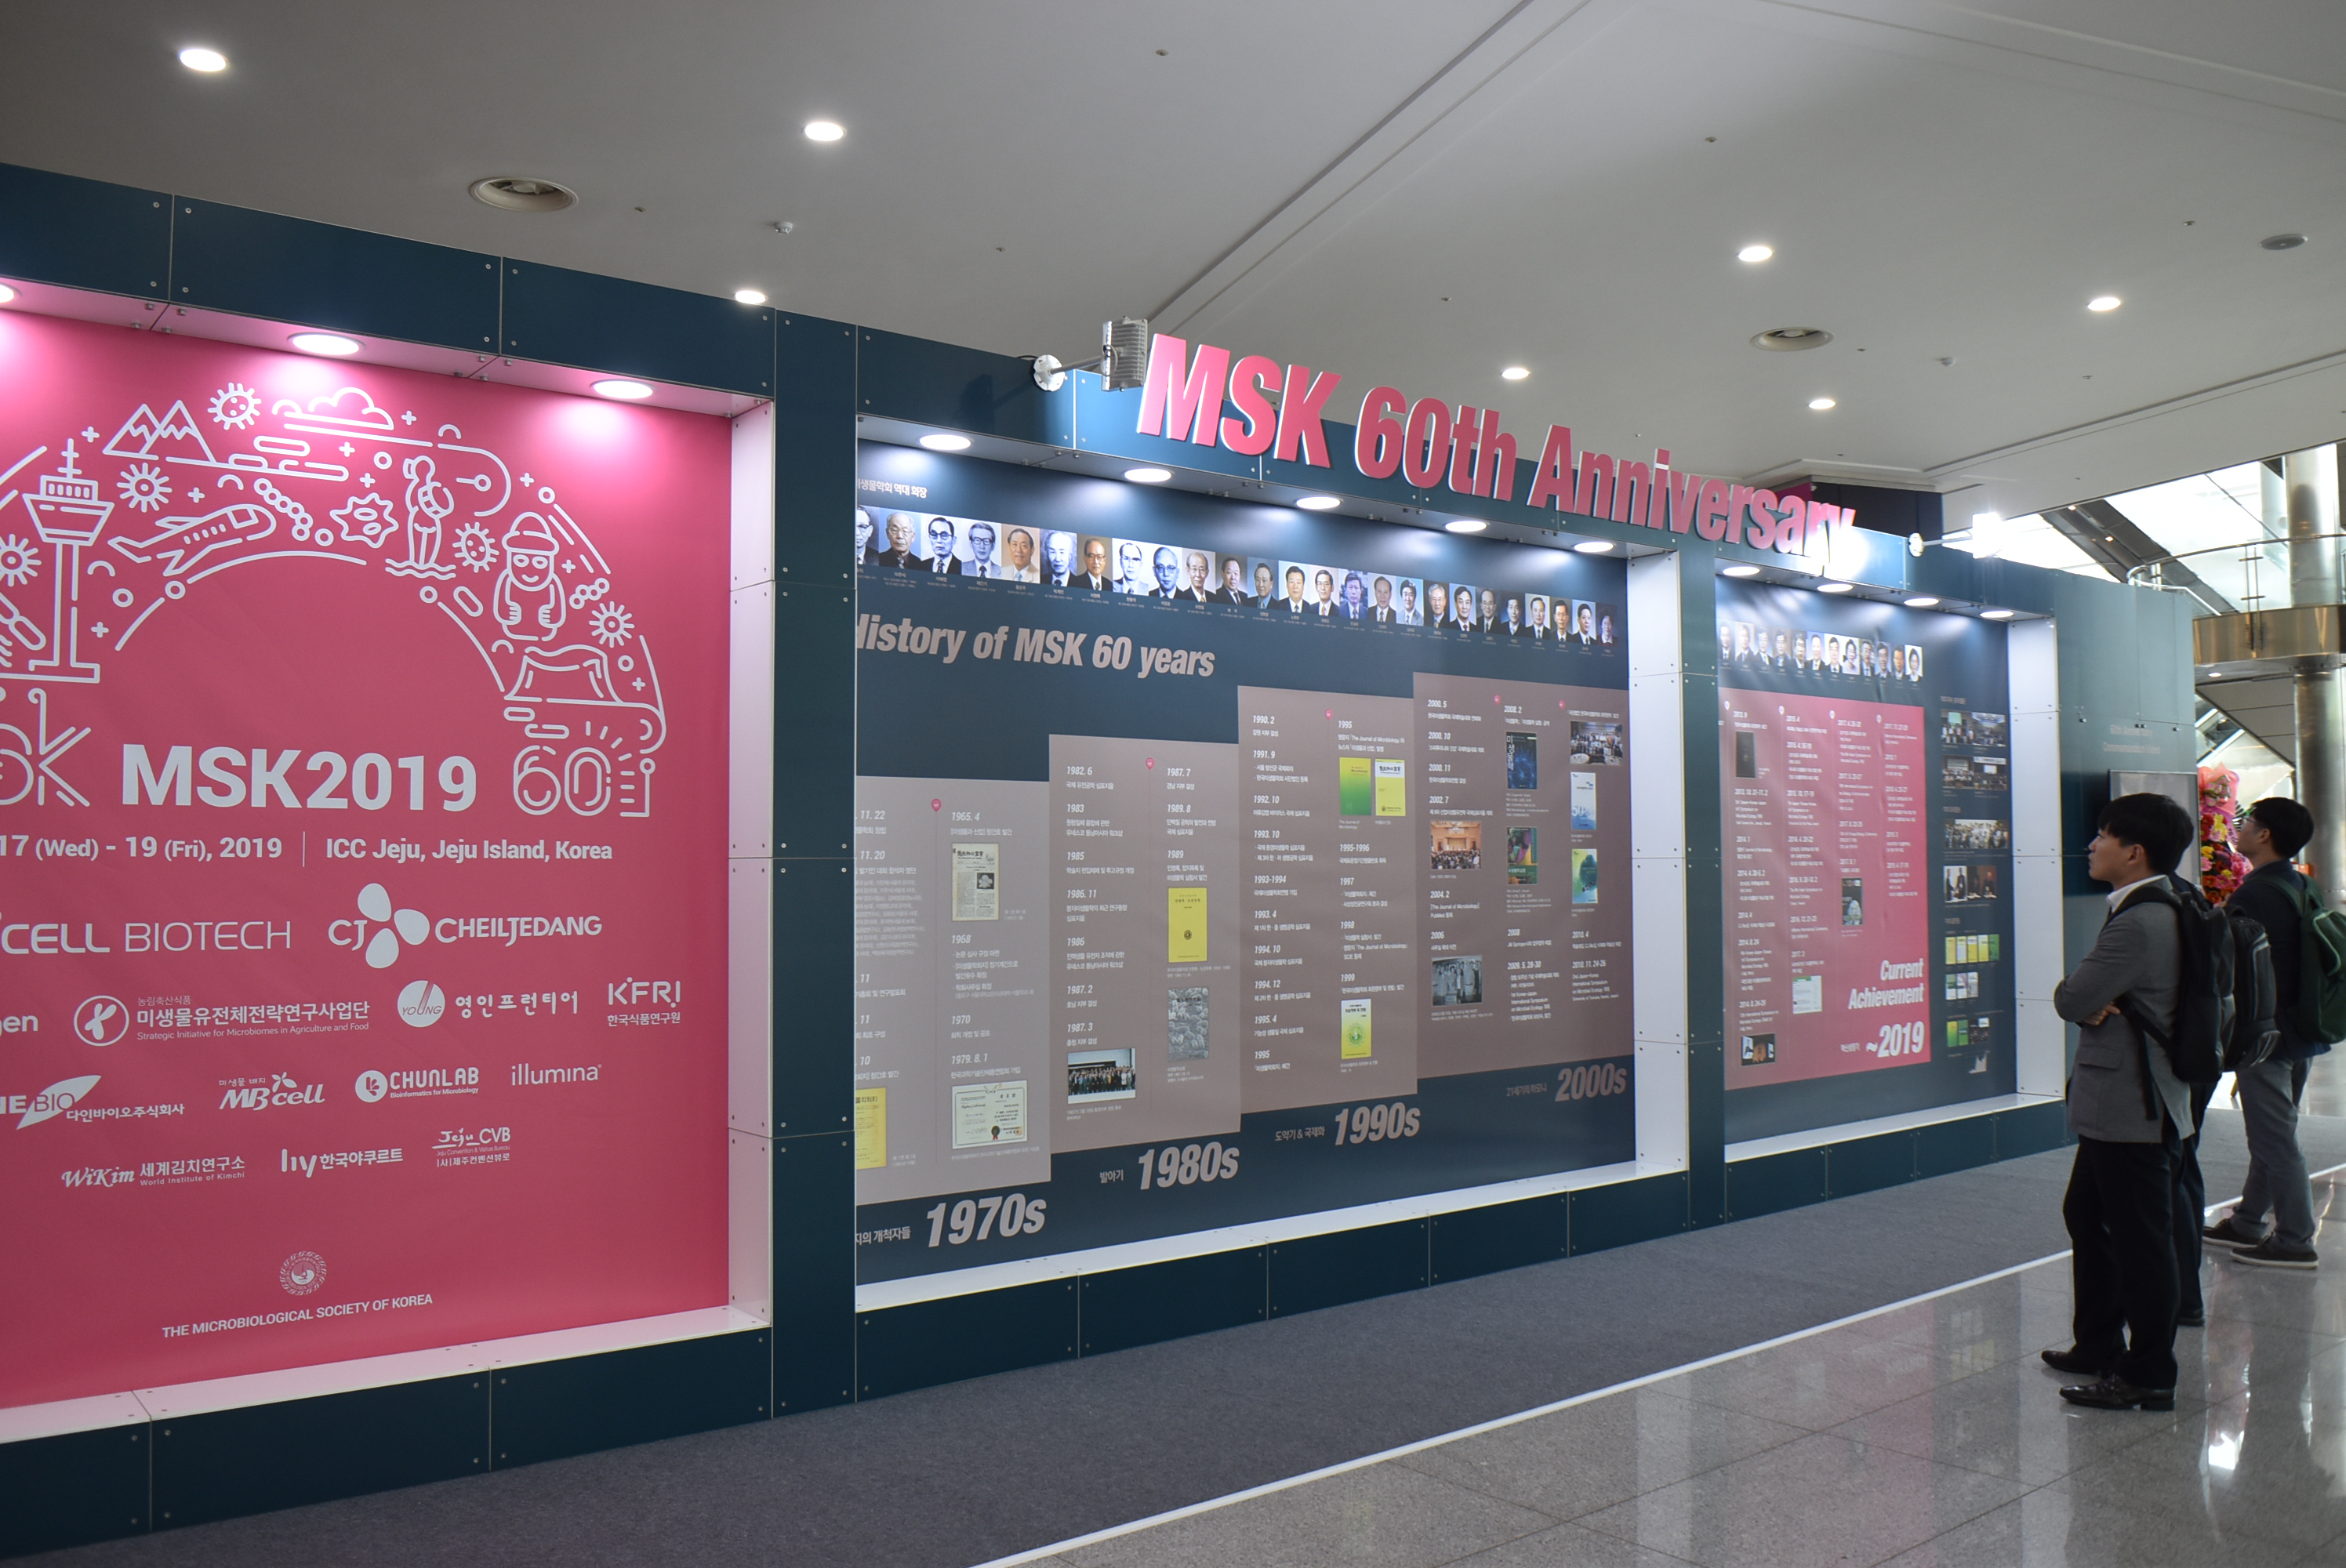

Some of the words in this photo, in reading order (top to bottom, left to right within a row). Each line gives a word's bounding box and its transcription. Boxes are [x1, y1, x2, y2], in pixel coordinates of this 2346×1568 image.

[1135, 332, 1342, 468] MSK
[1354, 386, 1517, 502] 60th
[1528, 423, 1857, 566] Anniversary
[894, 483, 910, 495] 역대
[911, 485, 928, 499] 회장
[972, 626, 1008, 659] of
[1014, 629, 1087, 666] MSK
[1092, 634, 1131, 670] 60
[1137, 644, 1215, 678] years
[1443, 700, 1447, 709] 5
[1252, 715, 1269, 724] 1990.
[1270, 716, 1275, 724] 2
[1338, 720, 1353, 729] 1995
[1444, 732, 1451, 741] 10
[1253, 750, 1269, 759] 1991.
[1270, 750, 1276, 759] 9
[1066, 766, 1086, 775] 1982.
[1088, 767, 1092, 775] 6
[1167, 768, 1185, 776] 1987.
[1186, 768, 1191, 777] 7
[1444, 764, 1451, 772] 11
[122, 743, 477, 812] MSK2019
[1254, 795, 1270, 804] 1992.
[1272, 795, 1280, 804] 10
[1444, 796, 1449, 804] 7
[1066, 804, 1084, 813] 1983
[1167, 804, 1185, 813] 1989.
[1186, 804, 1191, 813] 8
[874, 810, 885, 820] 22
[951, 811, 973, 821] 1965.
[974, 812, 980, 821] 4
[1254, 830, 1271, 839] 1993.
[1272, 830, 1280, 839] 10
[35, 839, 99, 861] (Wed)
[126, 836, 158, 857] 19
[164, 840, 212, 862] (Fri),
[220, 837, 282, 858] 2019
[326, 838, 367, 858] ICC
[372, 837, 427, 863] Jeju,
[432, 840, 478, 863] Jeju
[483, 840, 550, 863] Island,
[555, 840, 613, 859] Korea
[1339, 844, 1370, 852] 1995-1996
[874, 851, 885, 860] 20
[1066, 851, 1084, 861] 1985
[1167, 850, 1184, 858] 1989
[1254, 875, 1287, 884] 1993-1994
[1340, 877, 1355, 886] 1997
[1066, 889, 1087, 898] 1986.
[1088, 889, 1097, 898] 11
[1255, 910, 1271, 919] 1993.
[1272, 909, 1276, 919] 4
[1341, 920, 1355, 930] 1998
[1, 924, 111, 954] CELL
[125, 921, 291, 953] BIOTECH
[328, 919, 368, 951] CJ
[434, 915, 602, 947] CHEILJEDANG
[951, 935, 971, 944] 1968
[1066, 937, 1085, 946] 1986
[1255, 945, 1272, 954] 1994.
[1273, 945, 1281, 953] 10
[1880, 957, 1924, 982] Current
[1341, 973, 1355, 982] 1999
[1066, 985, 1087, 994] 1987.
[1088, 985, 1093, 993] 2
[1255, 980, 1272, 989] 1994.
[1273, 980, 1281, 989] 12
[608, 977, 681, 1008] KFRI
[1847, 982, 1925, 1010] Achievement
[137, 995, 191, 1006] 농림축산식품
[456, 991, 578, 1018] 영인프런티어
[137, 1001, 370, 1028] 미생물유전체전략연구사업단
[401, 1002, 442, 1017] YOUNG
[607, 1012, 681, 1027] 한국식품연구원
[951, 1015, 971, 1025] 1970
[1255, 1015, 1272, 1025] 1995.
[1272, 1014, 1277, 1024] 4
[0, 1015, 38, 1037] en
[137, 1030, 175, 1041] Strategic
[176, 1029, 212, 1039] Initiative
[212, 1029, 225, 1037] for
[227, 1025, 278, 1036] Microbiomes
[280, 1025, 288, 1034] in
[289, 1024, 332, 1035] Agriculture
[333, 1023, 348, 1032] and
[350, 1022, 369, 1031] Food
[1066, 1023, 1087, 1033] 1987.
[1088, 1022, 1093, 1032] 3
[951, 1054, 972, 1065] 1979.
[974, 1054, 982, 1064] 8.
[984, 1053, 988, 1062] 1
[1255, 1050, 1270, 1059] 1995
[390, 1066, 479, 1090] CHUNLAB
[510, 1063, 599, 1086] illumina
[219, 1077, 246, 1087] 미생물
[249, 1076, 266, 1085] 배지
[1555, 1063, 1628, 1102] 2000s
[390, 1088, 433, 1099] Bioinformatics
[442, 1087, 479, 1096] Microbiology
[34, 1093, 75, 1112] BIO
[66, 1103, 185, 1123] 다인바이오주식회사
[1335, 1102, 1421, 1146] 1990s
[438, 1127, 474, 1148] Jeju
[479, 1126, 511, 1145] CVB
[1275, 1128, 1295, 1142] 도약기
[1296, 1131, 1303, 1139] &
[1305, 1127, 1325, 1139] 국제화
[319, 1147, 404, 1170] 한국야쿠르트
[140, 1156, 245, 1178] 세계김치연구소
[1138, 1141, 1240, 1191] 1980s
[61, 1167, 135, 1188] WiKim
[140, 1178, 165, 1186] World
[168, 1175, 203, 1185] Institute
[216, 1171, 245, 1181] Kimchi
[1099, 1169, 1124, 1184] 발아기
[926, 1192, 1047, 1247] 1970s
[873, 1225, 911, 1243] 개척자들
[162, 1325, 190, 1338] THE
[192, 1309, 314, 1334] MICROBIOLOGICAL
[316, 1301, 370, 1319] SOCIETY
[372, 1299, 390, 1312] OF
[392, 1294, 433, 1308] KOREA
